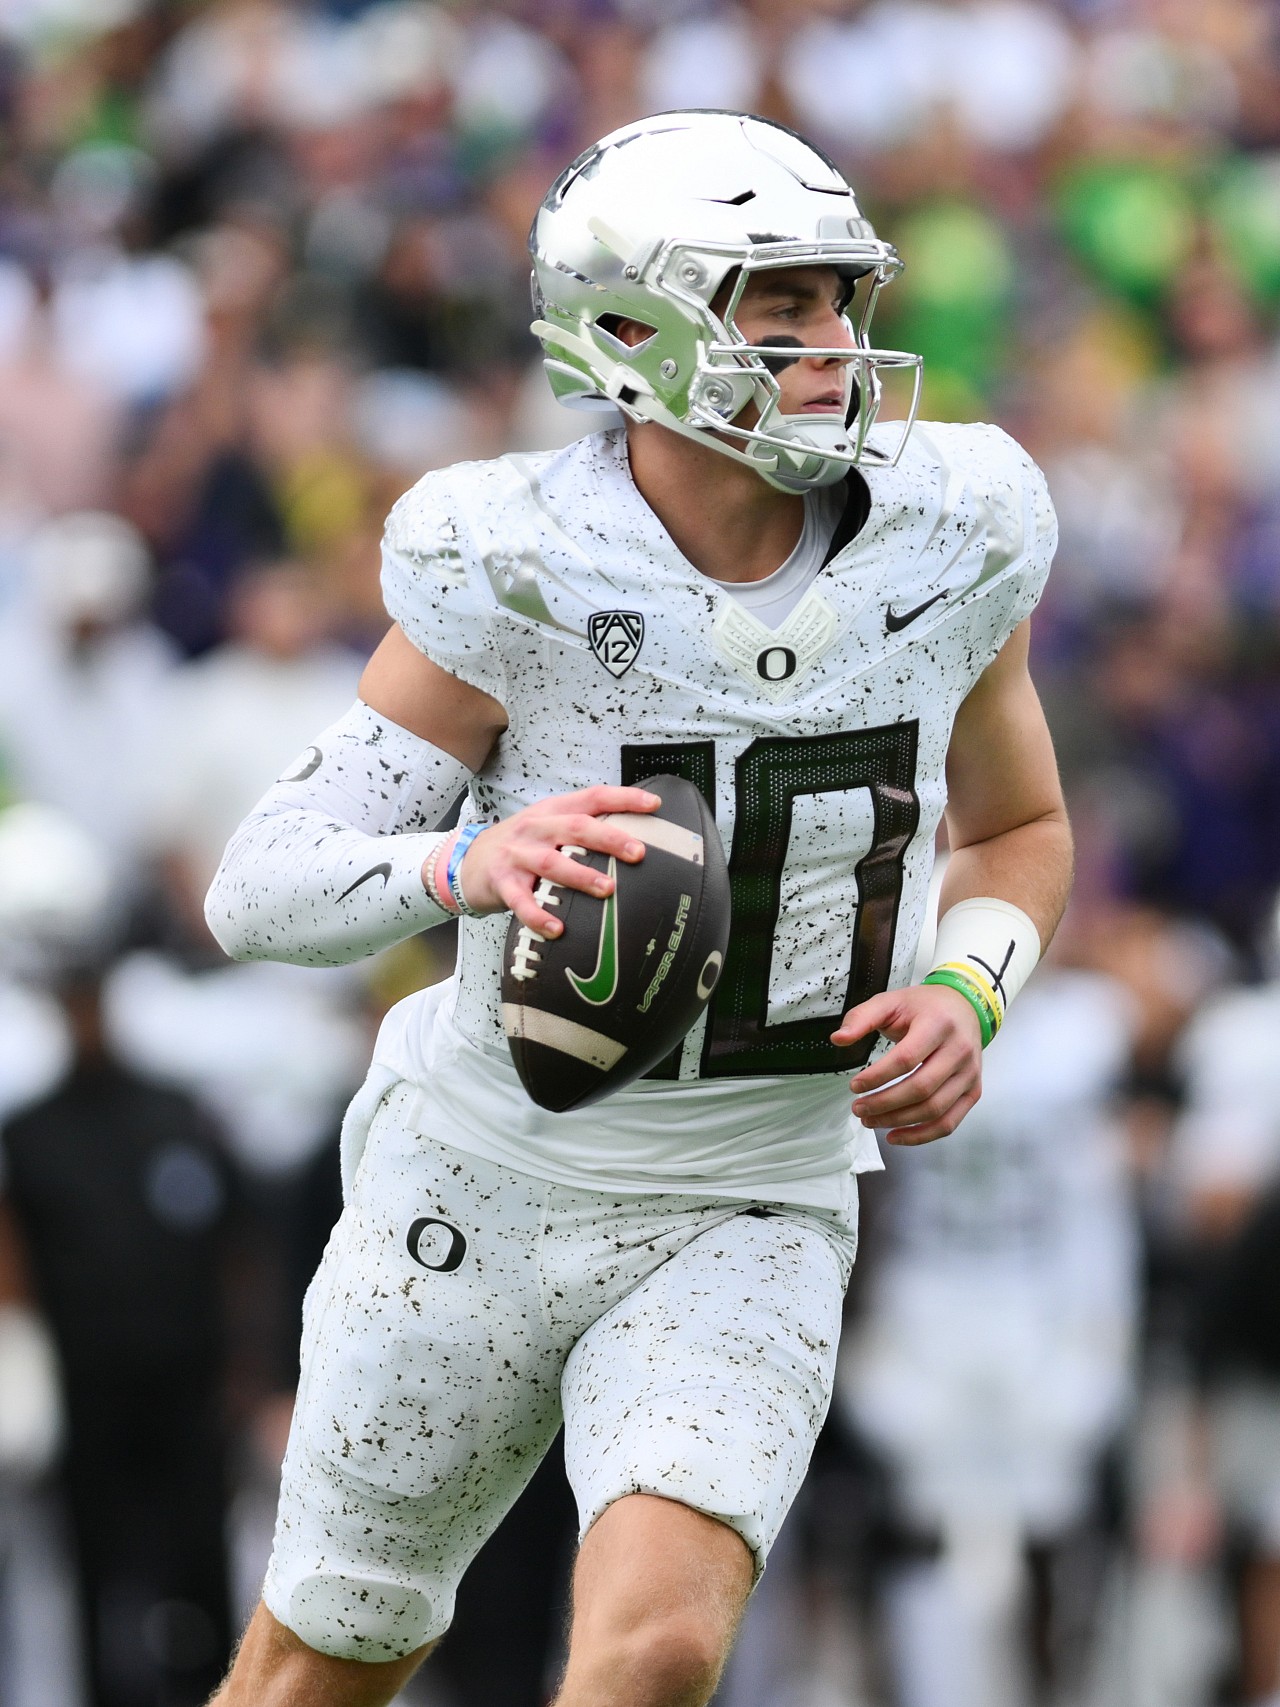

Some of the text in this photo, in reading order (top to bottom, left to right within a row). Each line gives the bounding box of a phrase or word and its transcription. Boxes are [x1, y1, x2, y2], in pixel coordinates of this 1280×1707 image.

[592, 614, 641, 650] PAC
[604, 640, 631, 663] 12
[620, 718, 920, 1080] 0
[667, 893, 692, 952] ELITE
